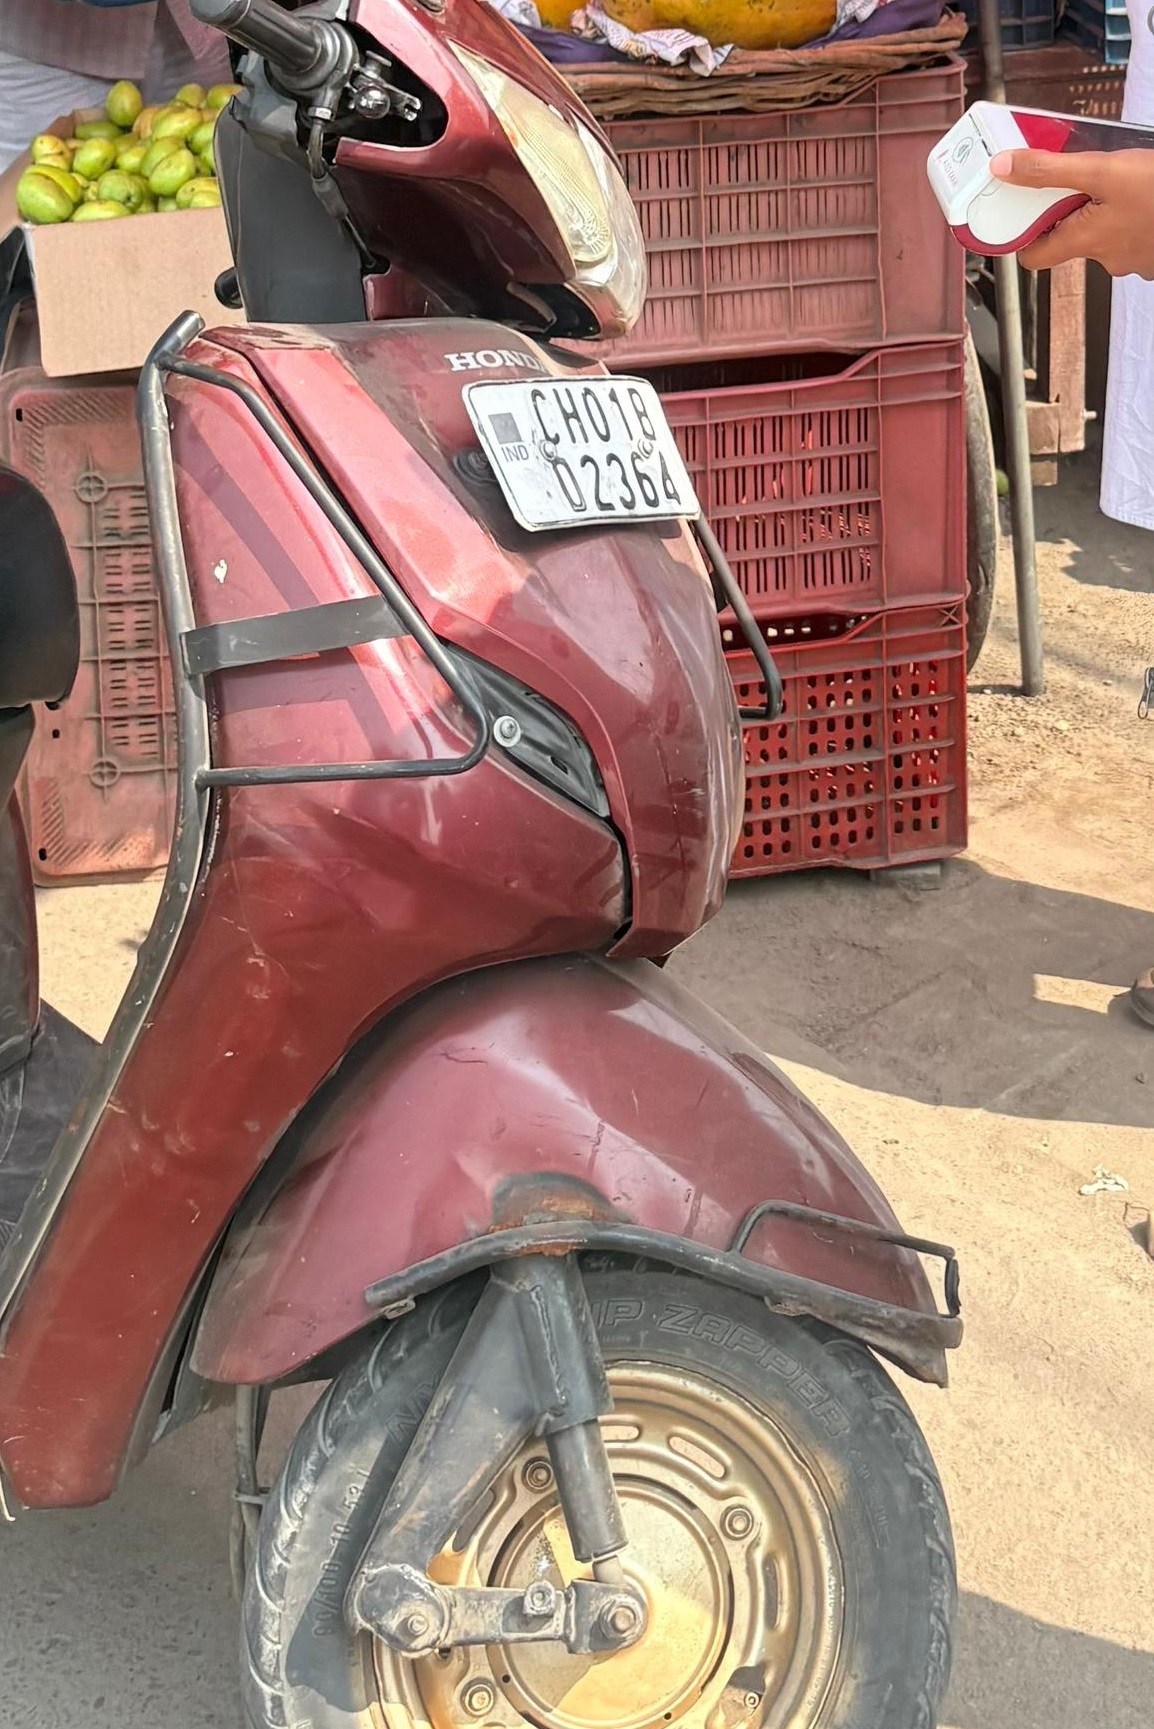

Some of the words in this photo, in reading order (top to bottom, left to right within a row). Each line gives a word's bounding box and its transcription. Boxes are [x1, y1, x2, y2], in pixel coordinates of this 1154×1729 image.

[531, 386, 657, 445] CH01B
[501, 444, 530, 464] IND
[552, 451, 682, 512] 02364
[655, 1303, 851, 1439] ZAPPER
